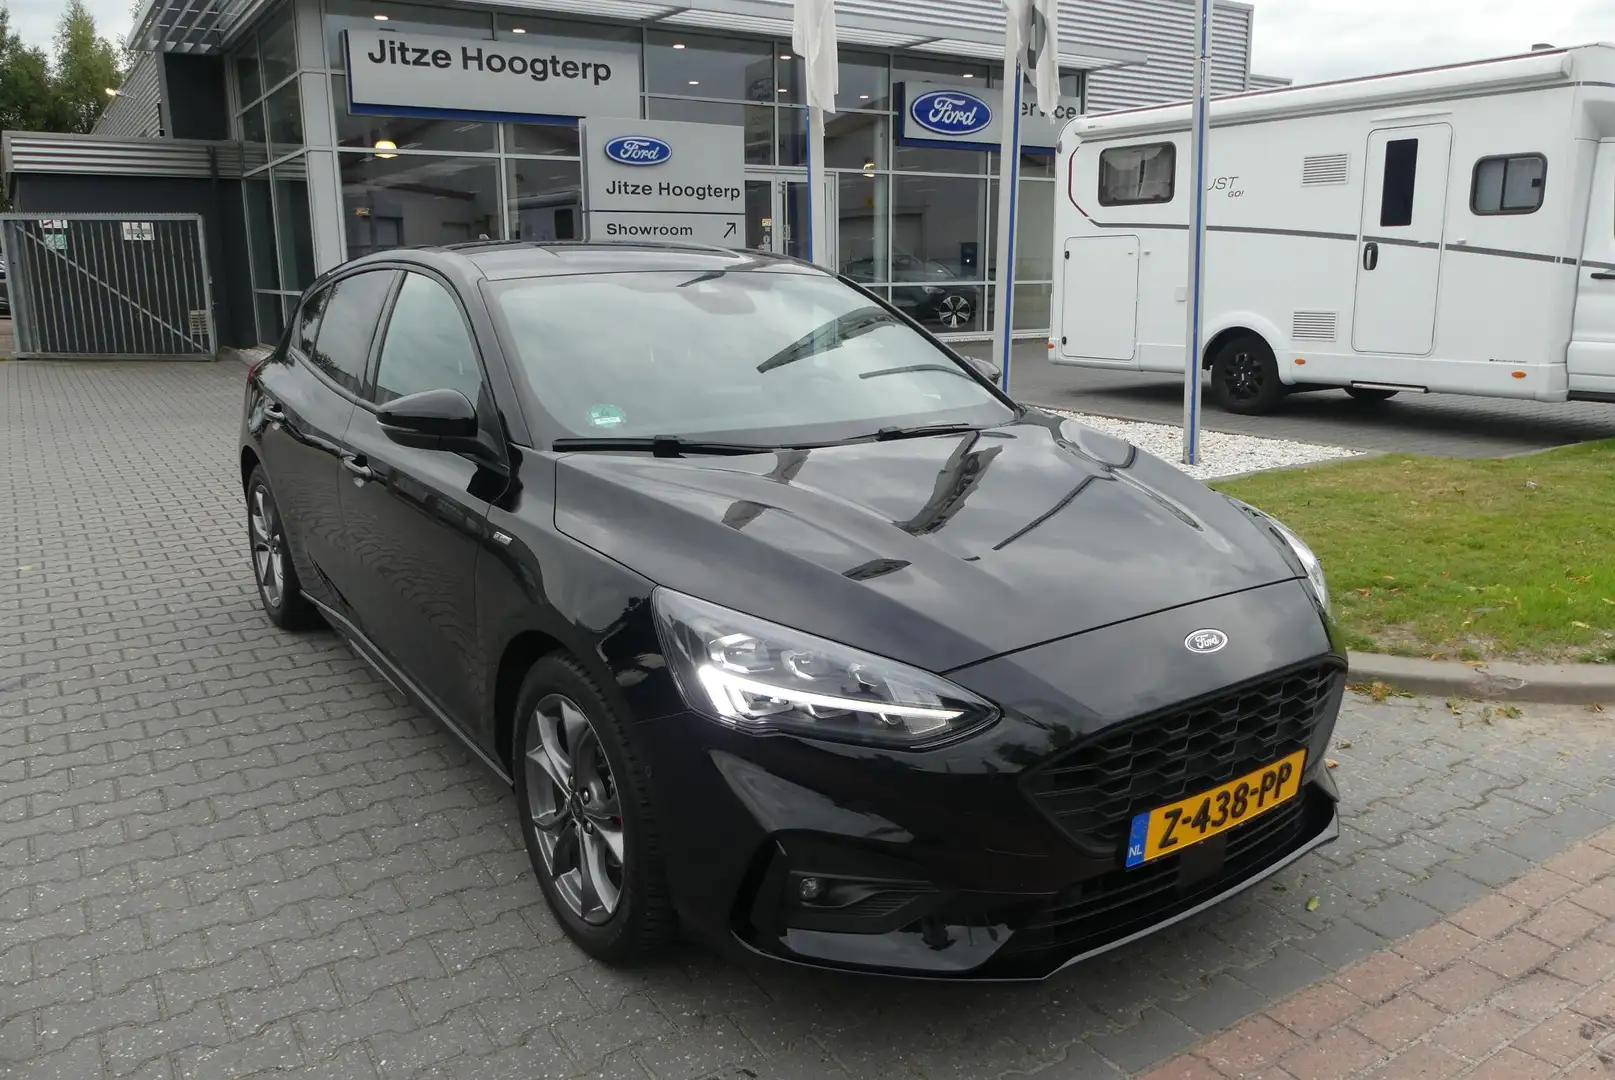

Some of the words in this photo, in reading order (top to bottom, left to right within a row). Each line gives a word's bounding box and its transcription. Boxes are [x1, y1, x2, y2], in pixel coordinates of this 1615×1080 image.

[368, 39, 452, 68] Jitze
[461, 47, 612, 85] Hoogterp
[928, 97, 978, 126] Ford
[1021, 101, 1077, 120] erce
[619, 141, 660, 161] Ford
[605, 181, 653, 197] Jitze
[658, 182, 741, 201] Hoogterp
[1206, 176, 1240, 190] UST
[1227, 190, 1244, 198] GO!
[606, 223, 693, 236] Showroom
[1194, 634, 1220, 649] Ford
[1158, 761, 1293, 849] Z-438-PP
[1128, 846, 1143, 857] NL
